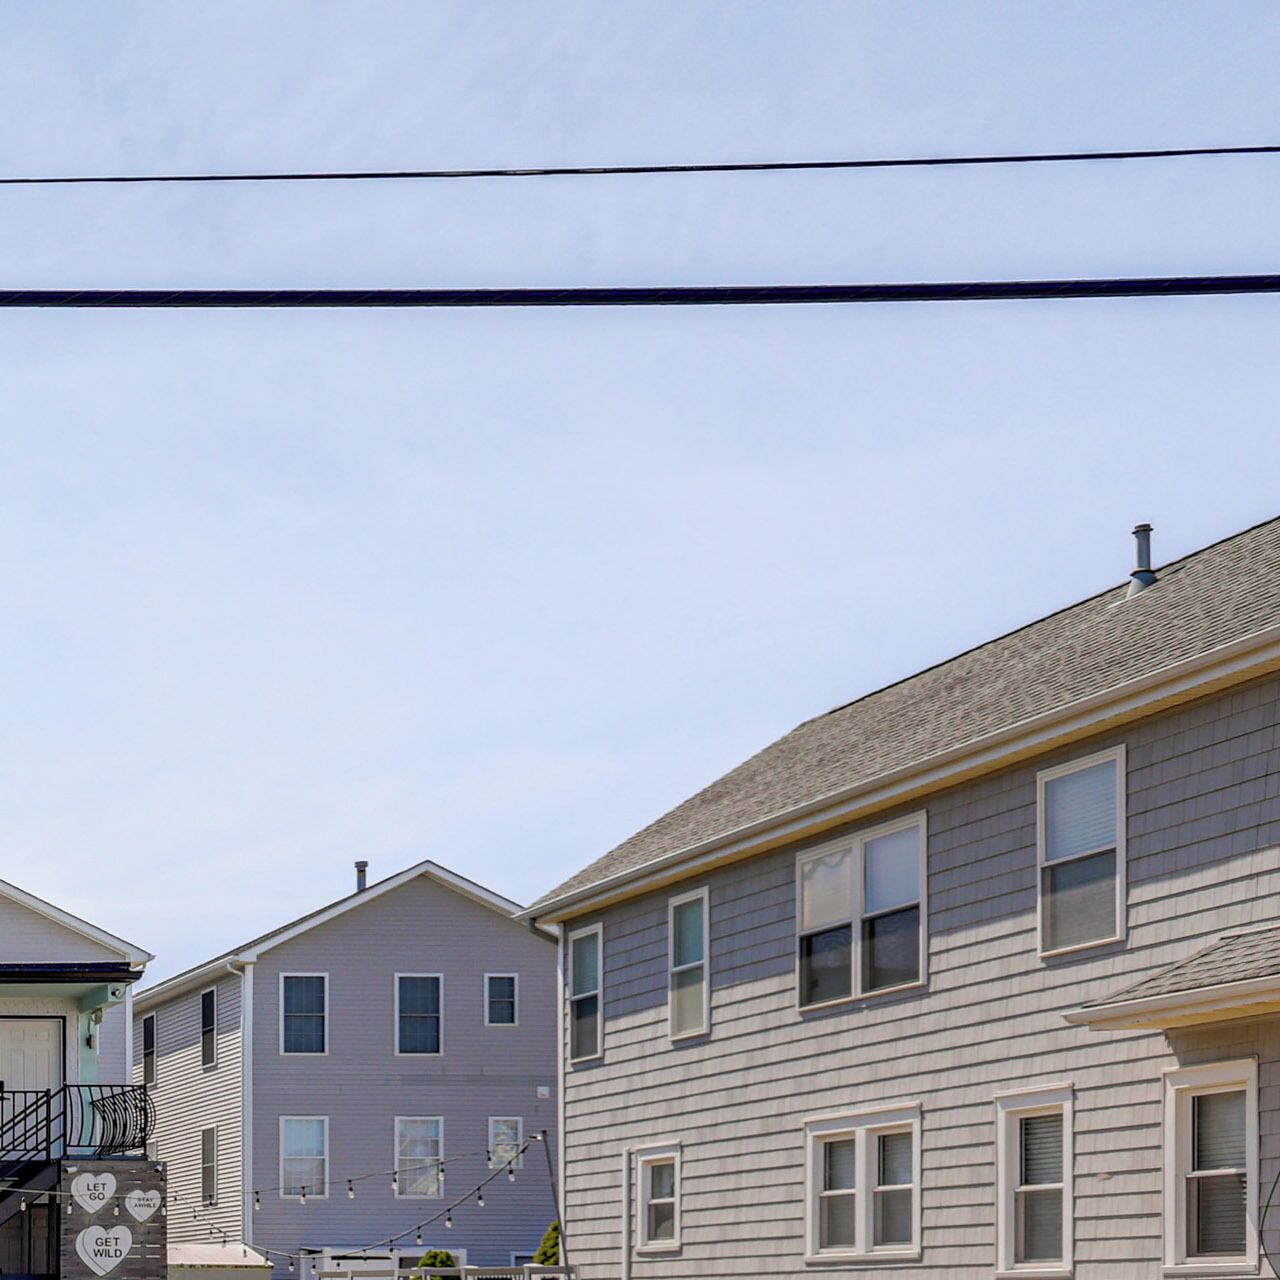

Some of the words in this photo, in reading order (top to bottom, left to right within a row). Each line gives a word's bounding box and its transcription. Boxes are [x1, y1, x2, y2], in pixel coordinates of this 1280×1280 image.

[87, 1183, 107, 1191] LET
[89, 1192, 105, 1200] GO
[95, 1237, 120, 1247] GET
[93, 1249, 122, 1258] WILD
